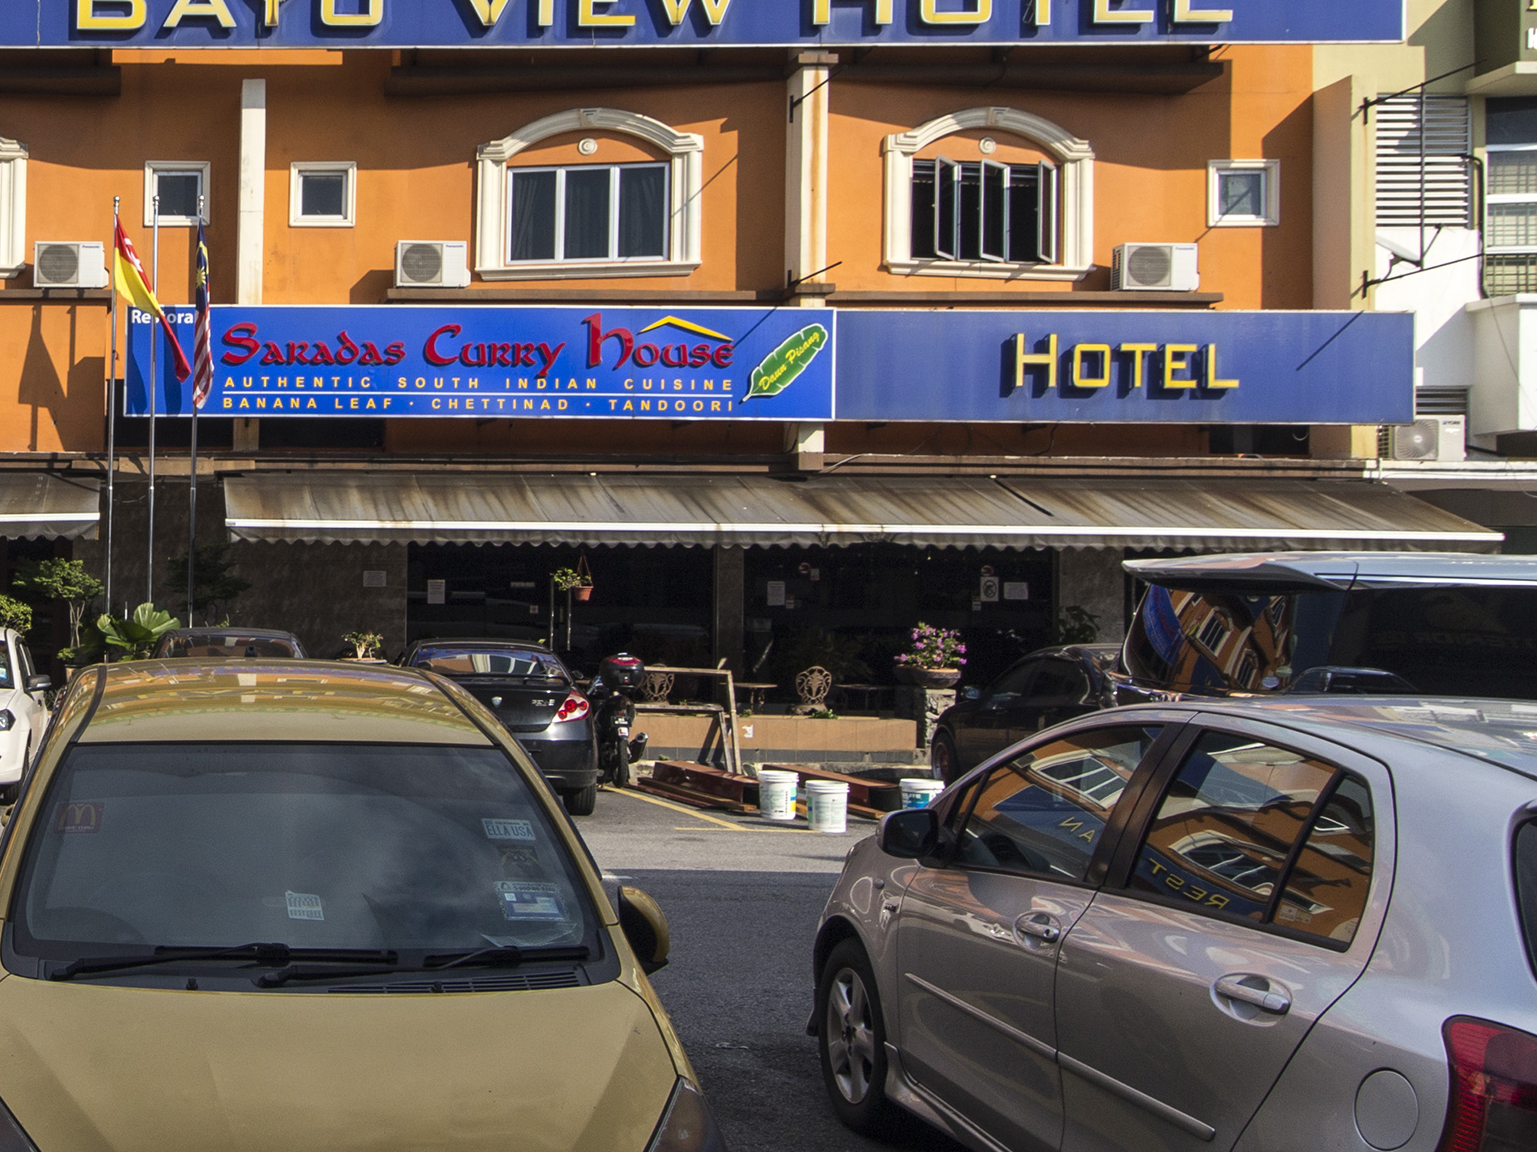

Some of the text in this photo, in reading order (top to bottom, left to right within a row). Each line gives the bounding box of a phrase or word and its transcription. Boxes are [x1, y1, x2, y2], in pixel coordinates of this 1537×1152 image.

[759, 332, 820, 390] Daun Pisang
[1015, 332, 1240, 390] HOTEL
[224, 376, 732, 391] AUTHENTIC SOUTH INDIAN CUISINE
[222, 397, 733, 412] BANANA LEAF CHETTINAD TANDOORI
